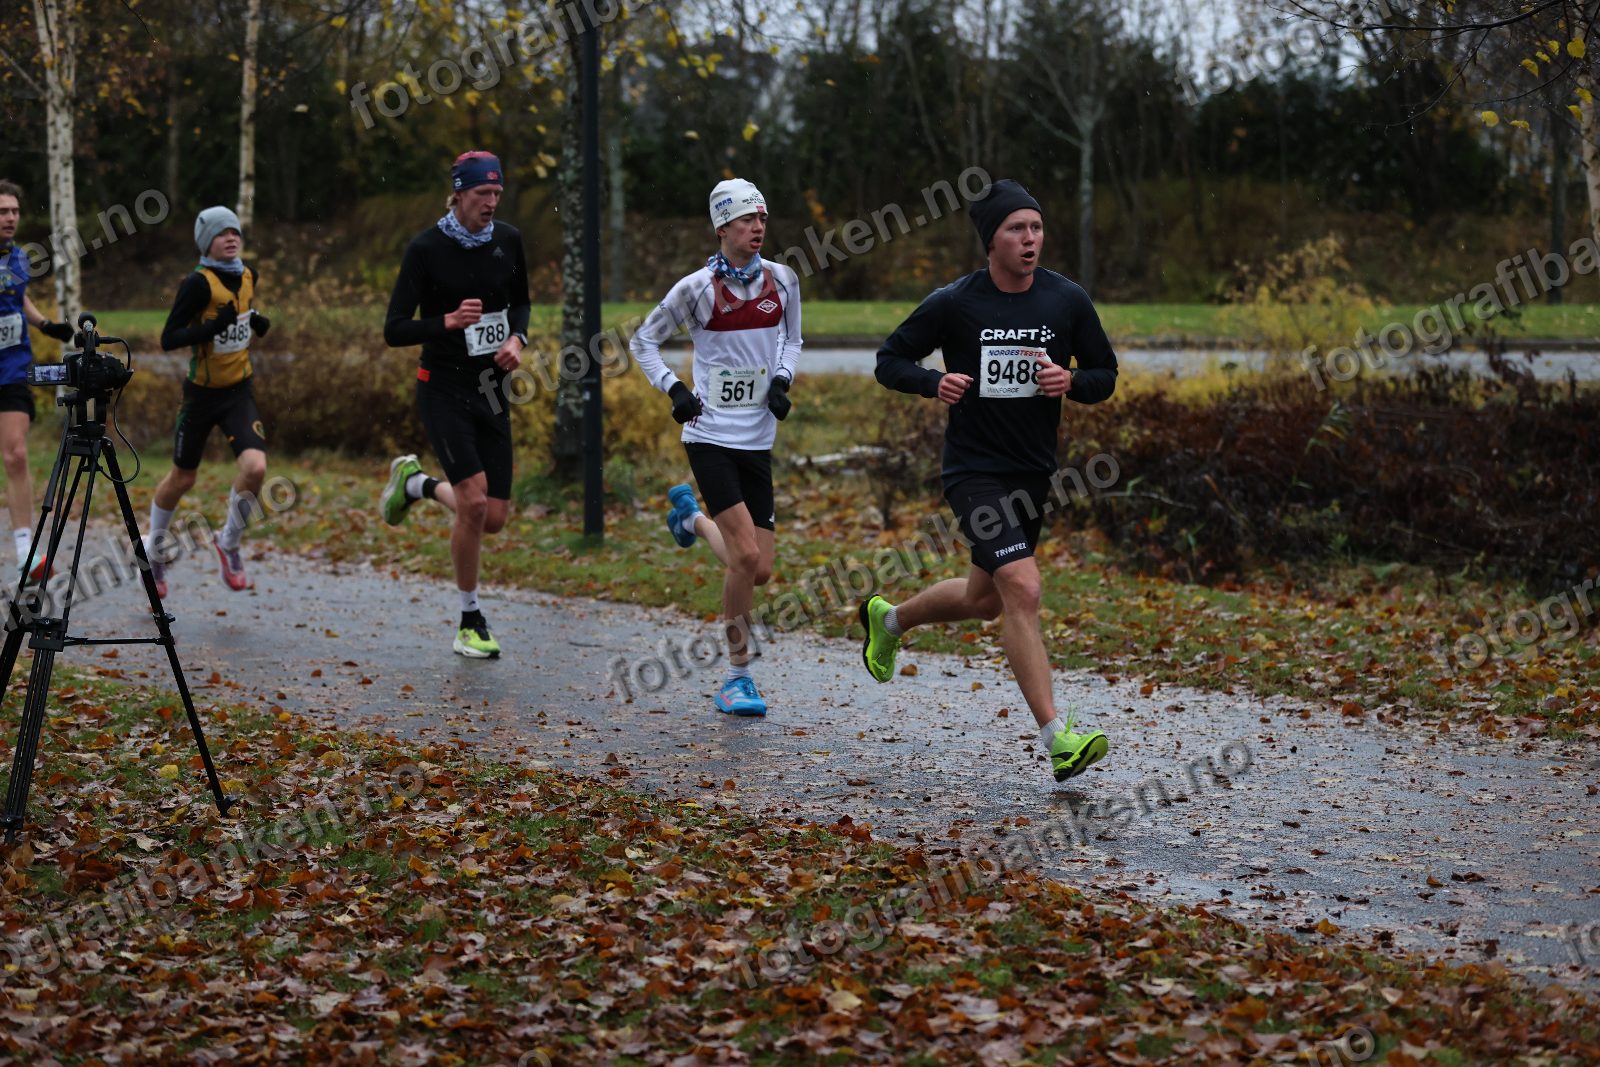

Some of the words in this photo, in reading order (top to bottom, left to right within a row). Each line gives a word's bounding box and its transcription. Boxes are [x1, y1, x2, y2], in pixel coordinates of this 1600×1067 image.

[0, 325, 15, 342] 91
[475, 323, 505, 346] 788
[980, 328, 1039, 341] CRAFT
[721, 380, 755, 402] 561
